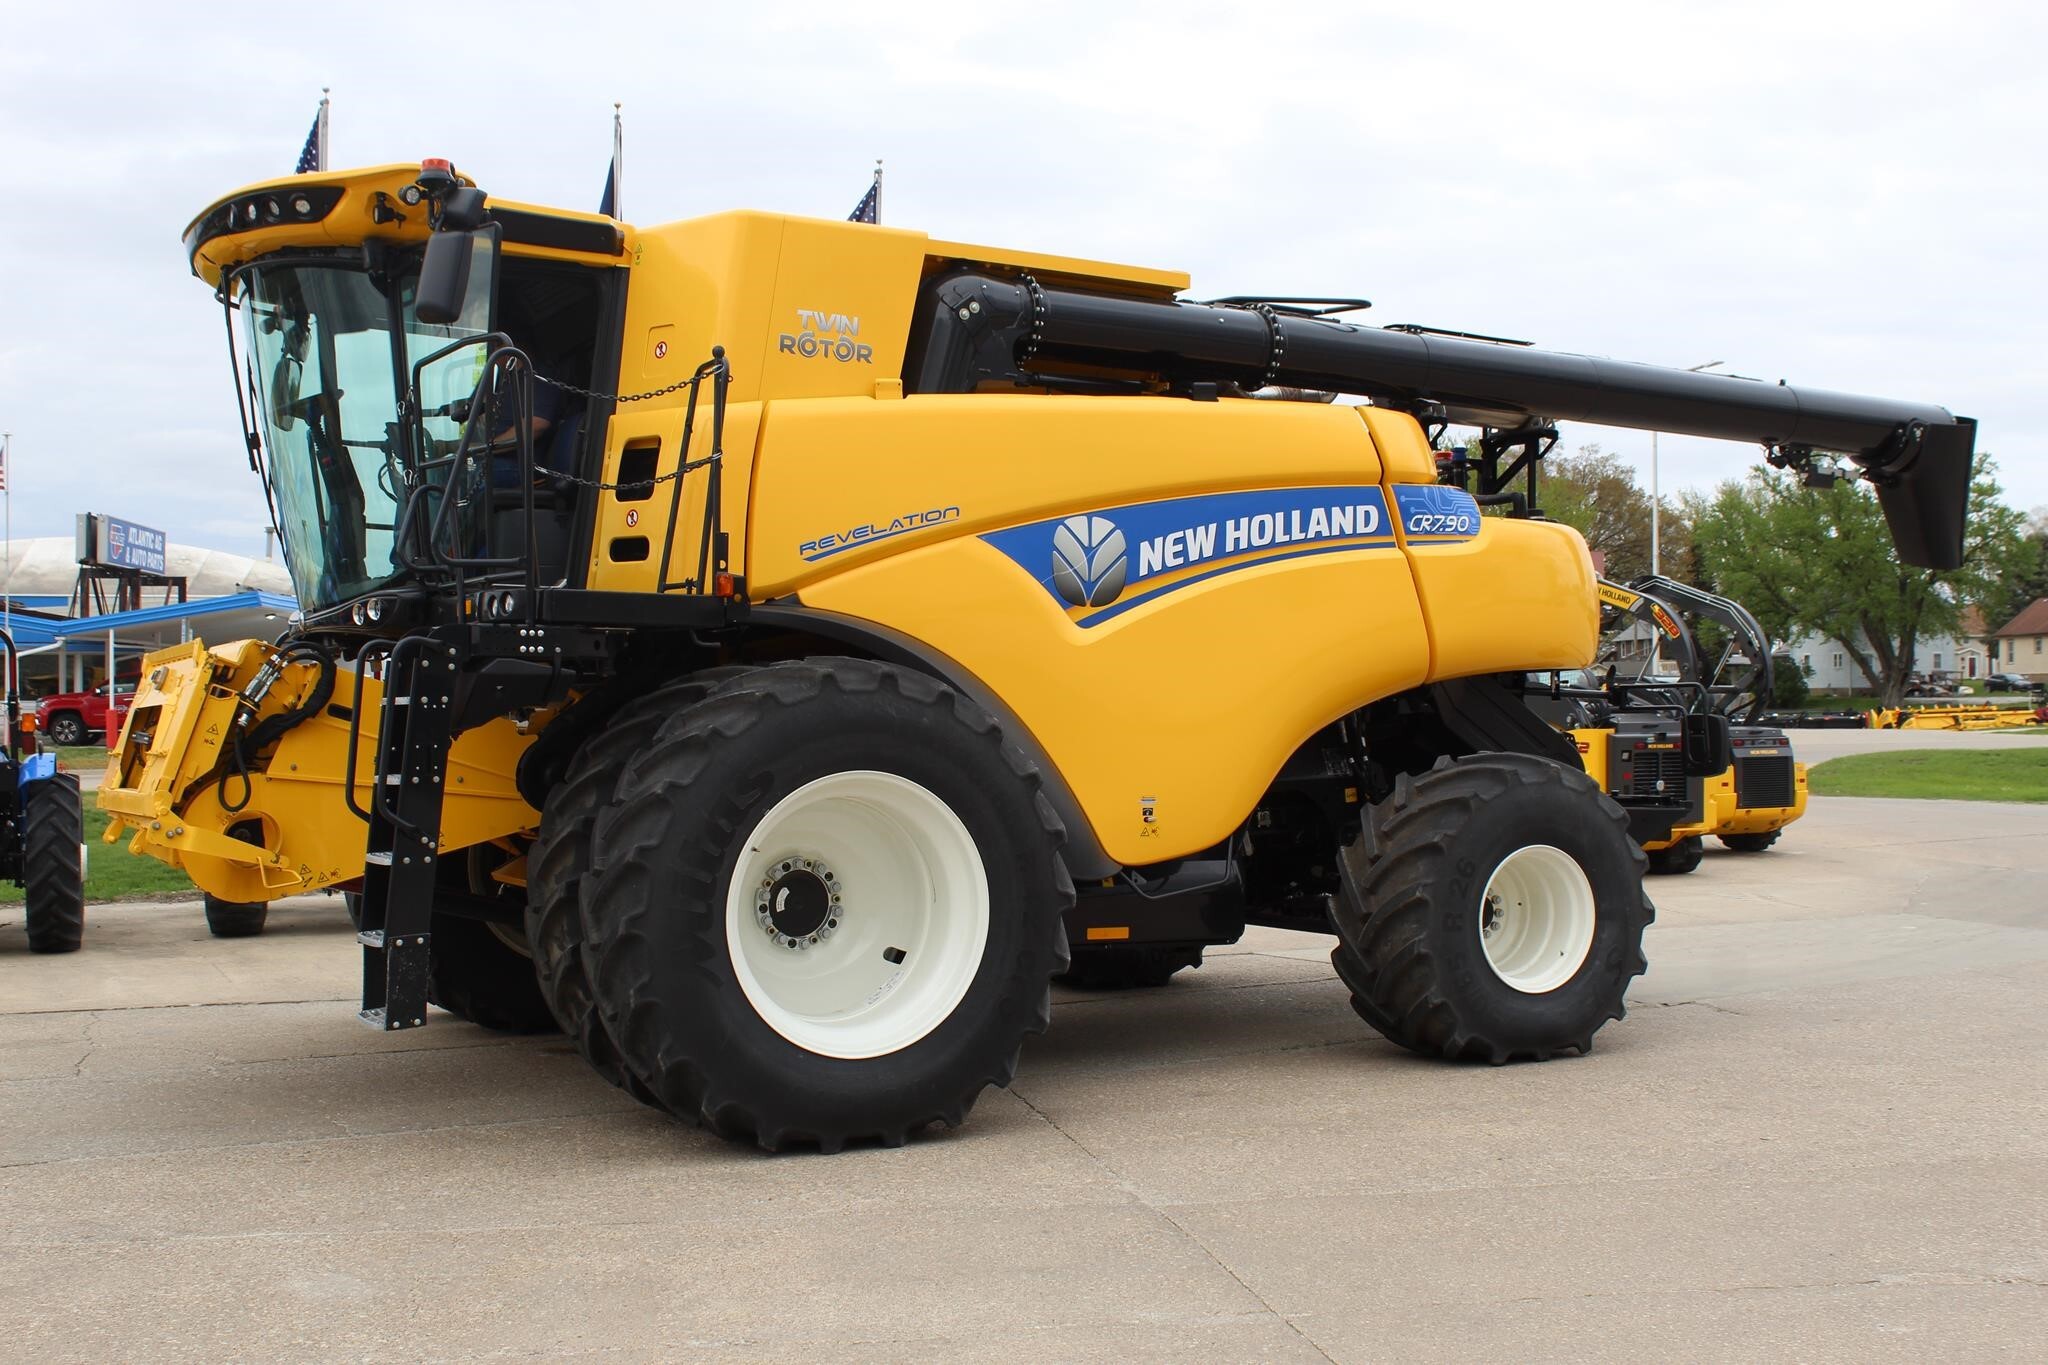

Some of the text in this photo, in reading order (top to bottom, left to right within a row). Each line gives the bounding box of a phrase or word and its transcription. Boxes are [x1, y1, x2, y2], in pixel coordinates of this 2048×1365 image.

[796, 308, 859, 337] TWIN
[779, 330, 873, 364] ROTOR
[128, 526, 154, 549] ATLANTIC
[799, 506, 960, 556] REVELATION
[1138, 504, 1380, 577] NEW HOLLAND
[125, 546, 164, 571] & AUTO PARTS
[1601, 587, 1631, 605] HOLLAND
